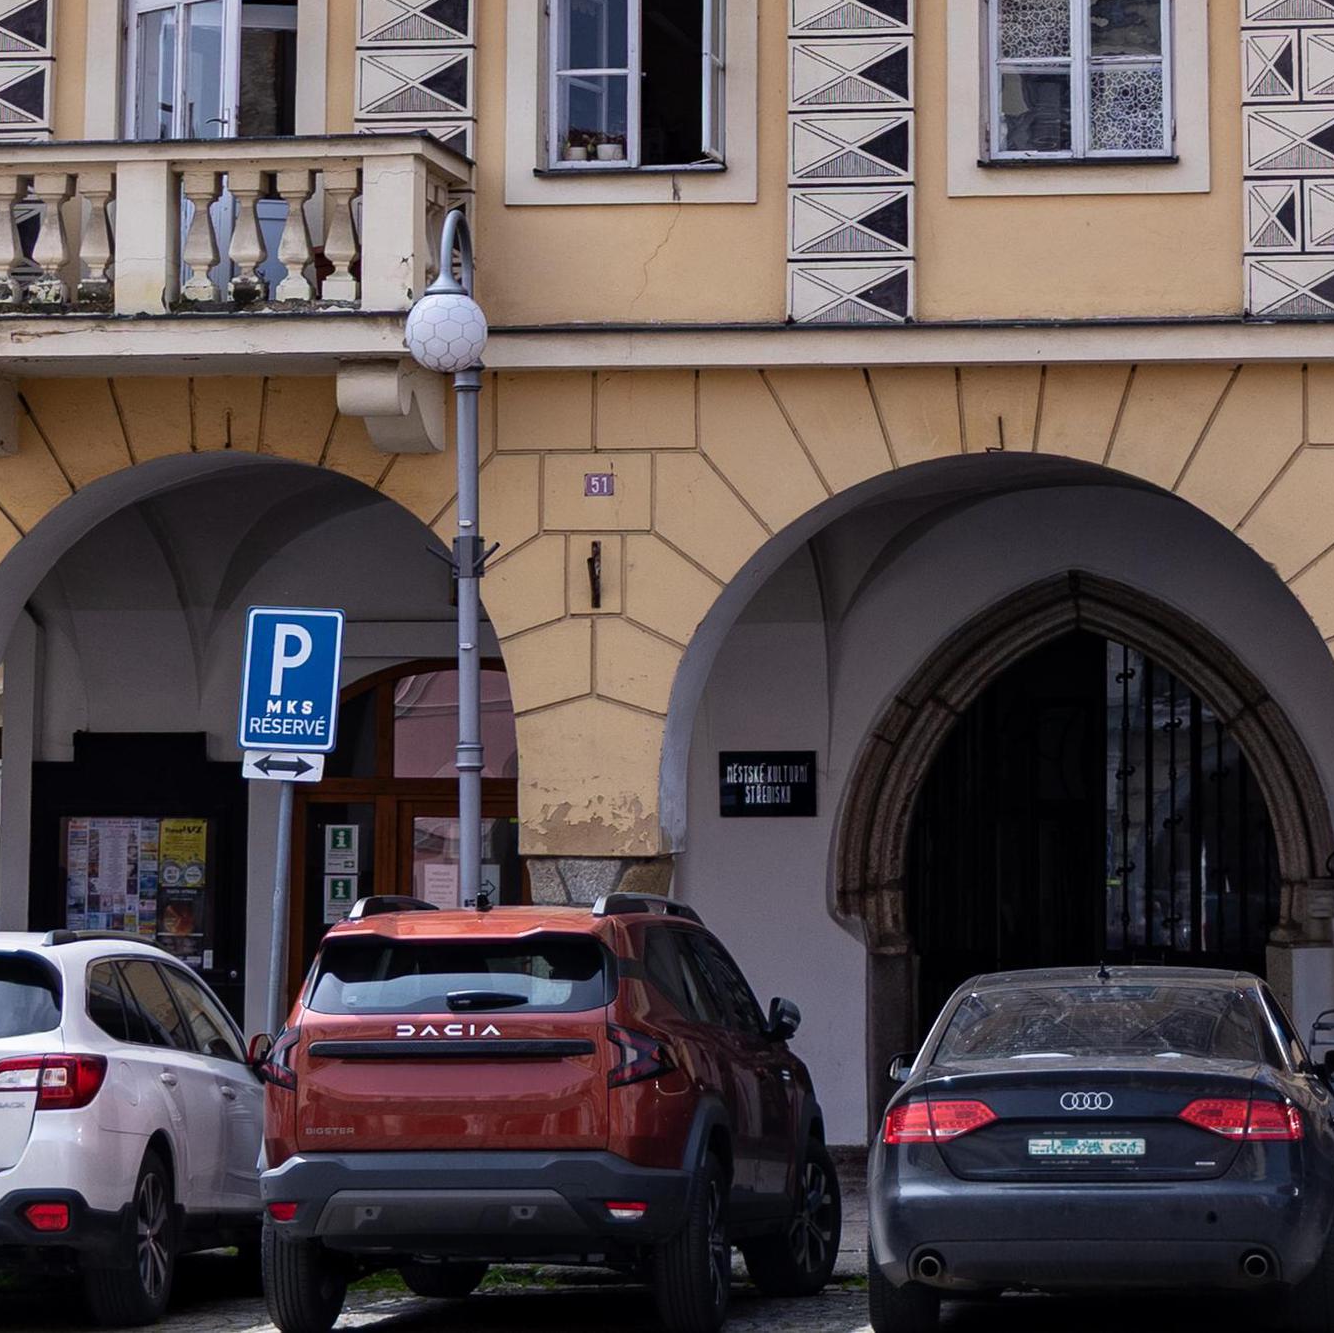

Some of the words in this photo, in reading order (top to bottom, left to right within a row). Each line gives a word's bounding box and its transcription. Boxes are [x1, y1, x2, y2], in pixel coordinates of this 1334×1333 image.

[591, 477, 607, 493] 51
[270, 623, 313, 696] P
[266, 699, 314, 715] MKS
[249, 714, 326, 736] RÉSERVÉ
[727, 763, 766, 783] MĚSTSKÉ
[745, 783, 791, 804] STŘEDISKO
[396, 1024, 501, 1036] DACIA
[304, 1127, 355, 1136] BIGSTER
